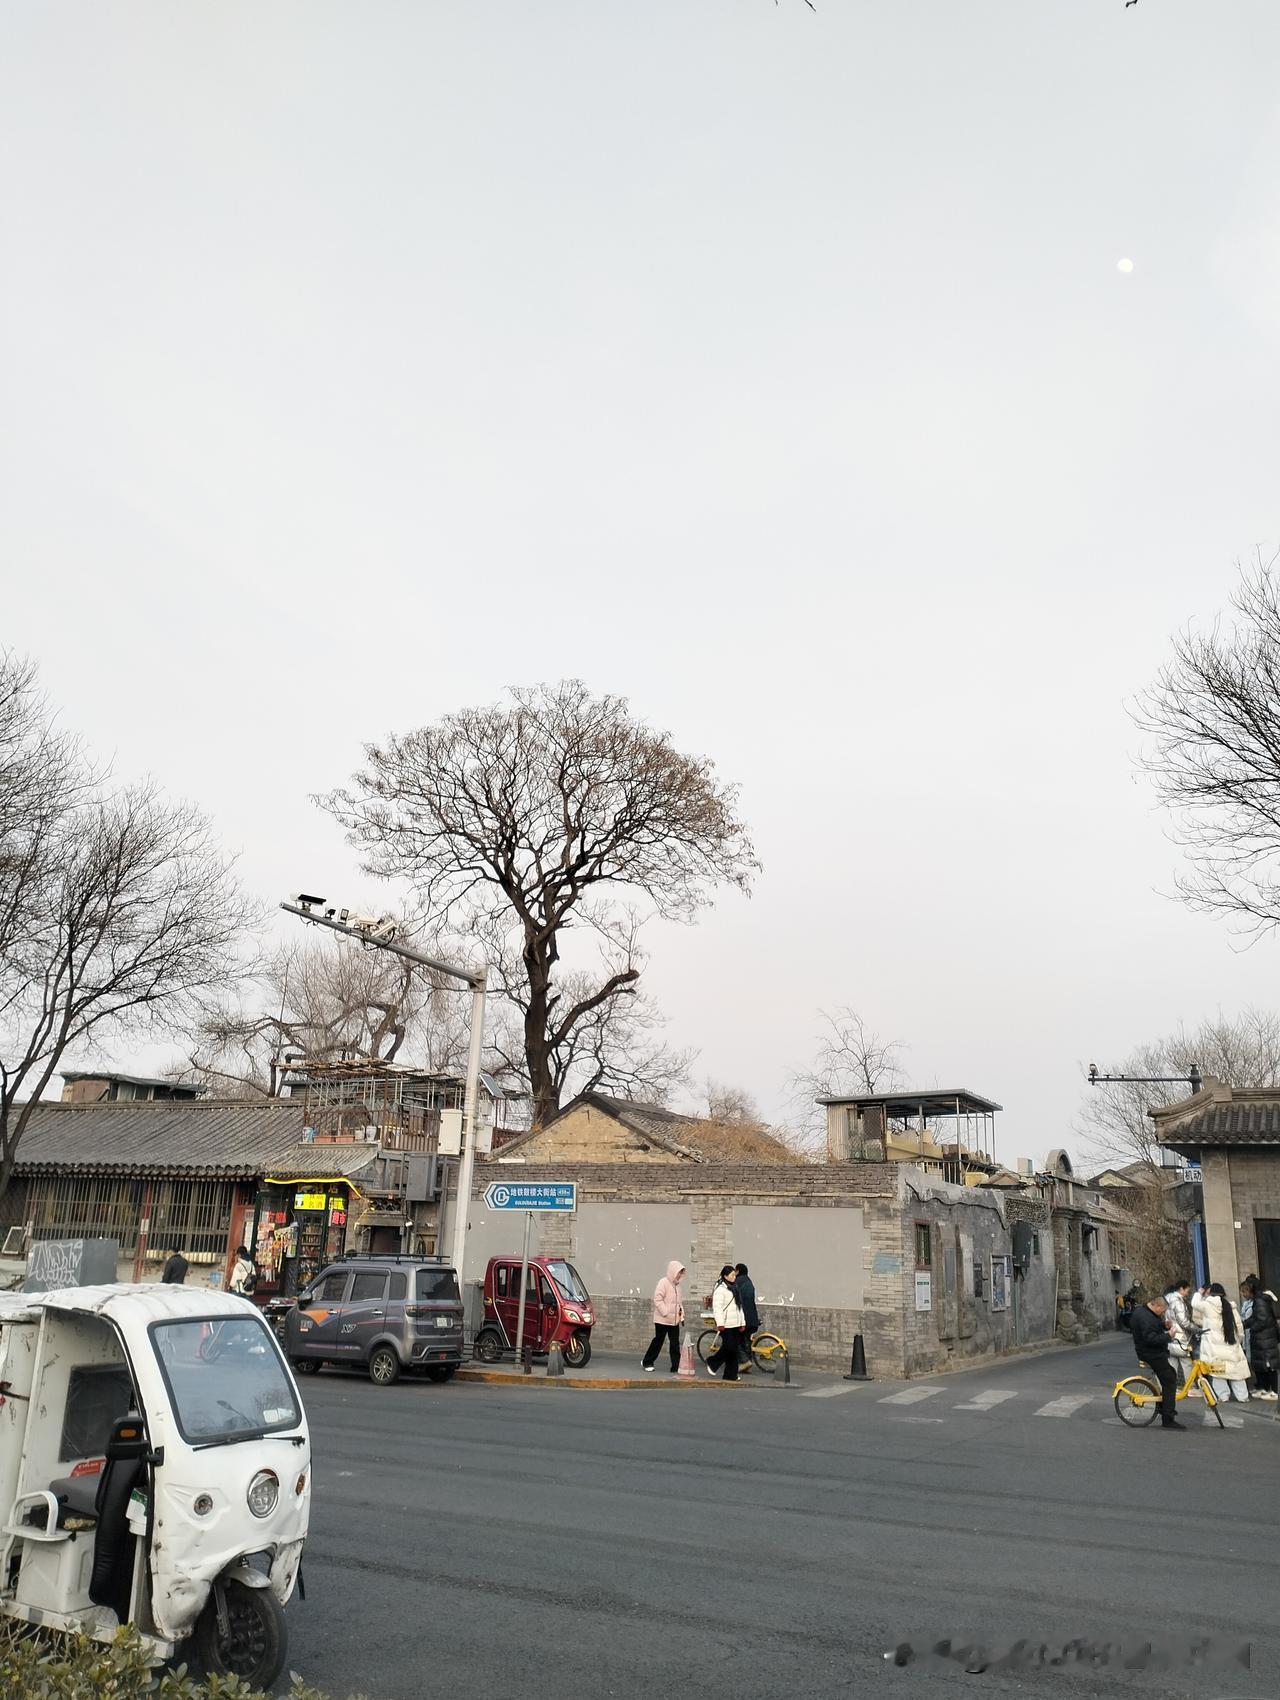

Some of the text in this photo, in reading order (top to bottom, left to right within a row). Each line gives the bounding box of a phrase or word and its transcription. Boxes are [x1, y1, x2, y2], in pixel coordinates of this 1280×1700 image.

[510, 1187, 557, 1197] 地铁鼓楼大街站
